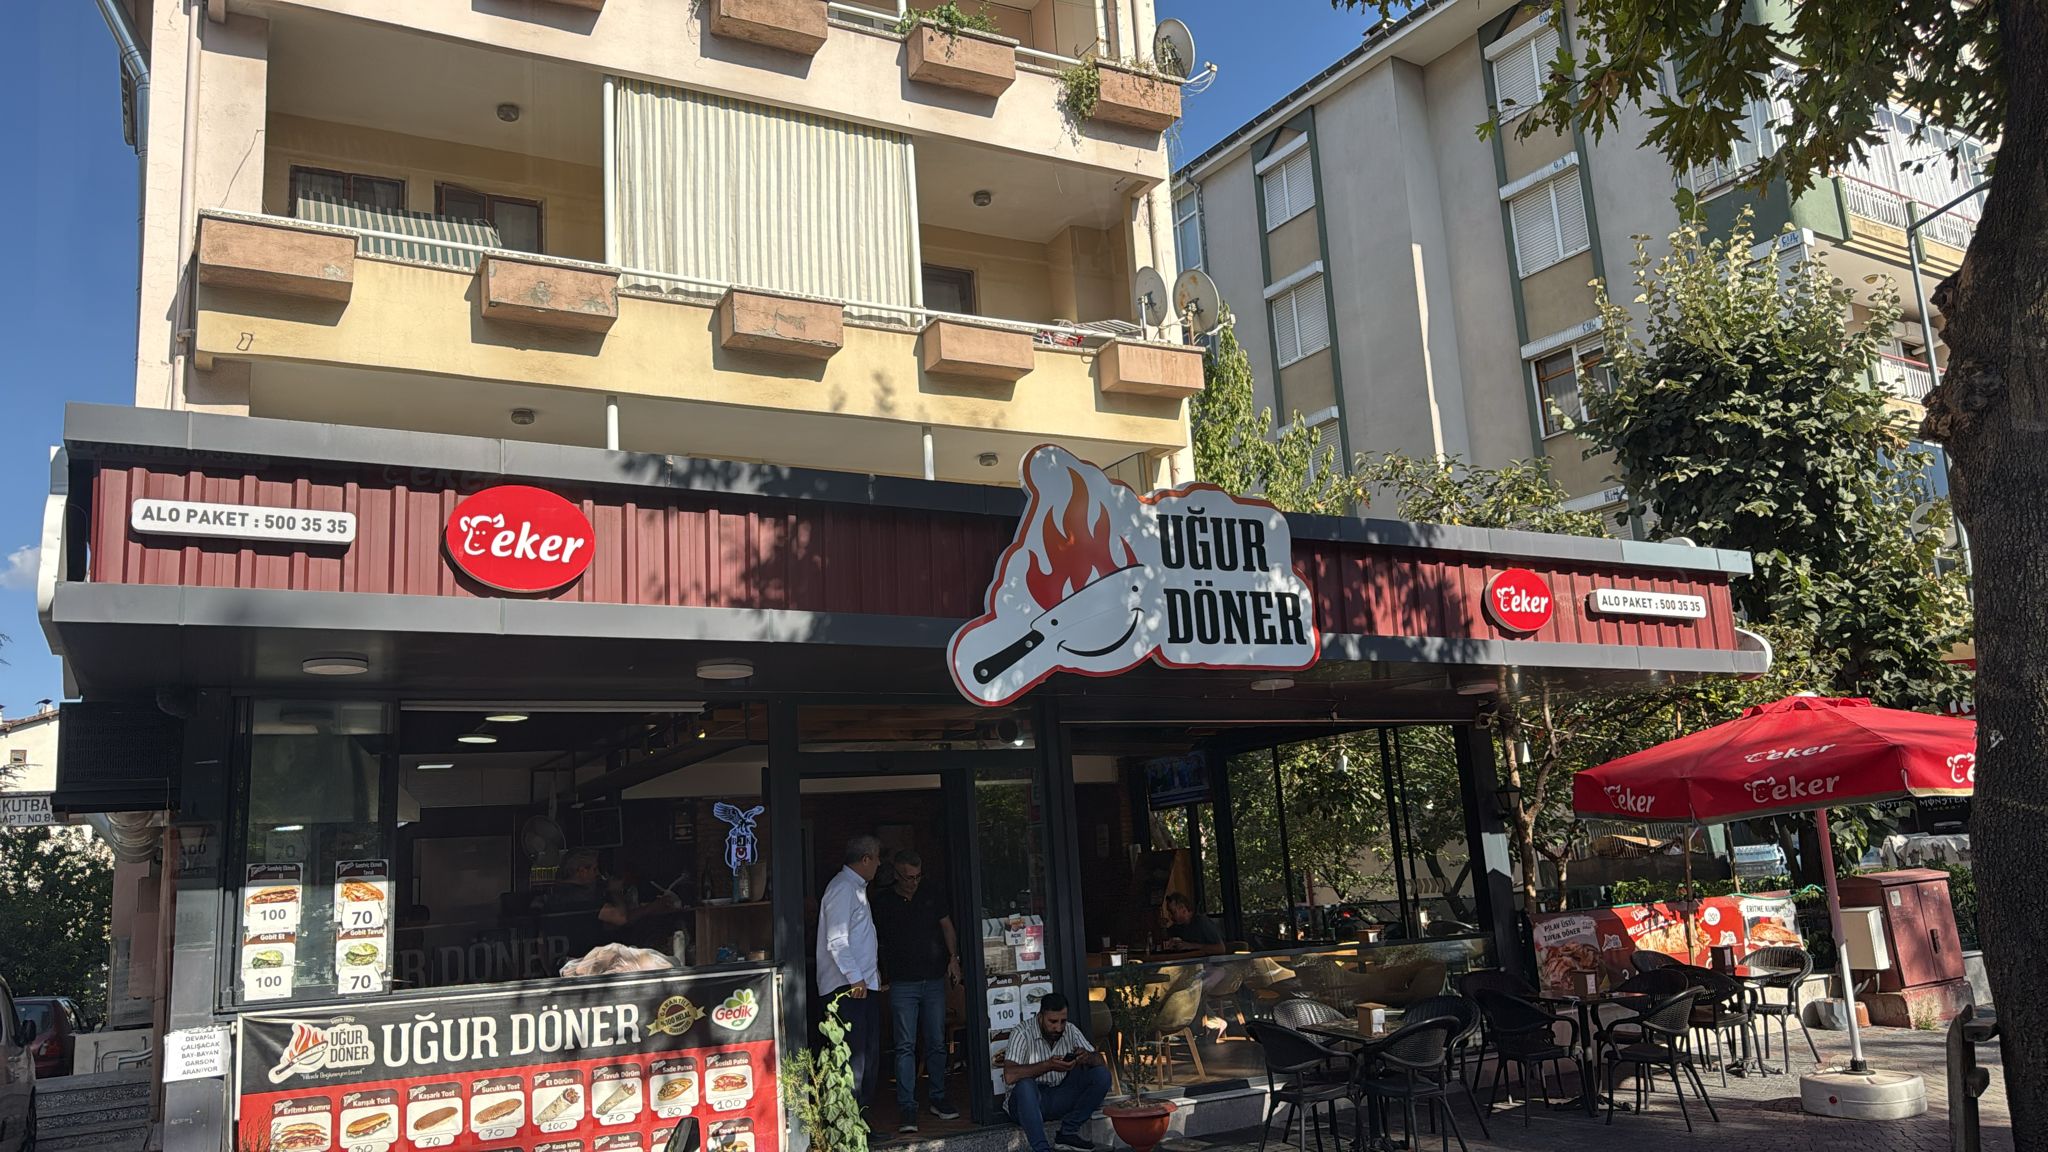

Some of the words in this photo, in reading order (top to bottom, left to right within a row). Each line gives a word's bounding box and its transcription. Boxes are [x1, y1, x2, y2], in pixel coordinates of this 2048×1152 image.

[142, 506, 180, 523] ALO
[186, 509, 249, 528] PAKET
[265, 515, 297, 532] 500
[301, 517, 323, 533] 35
[327, 520, 348, 534] 35
[491, 521, 585, 563] eker
[1156, 506, 1270, 572] UĞUR
[1511, 593, 1549, 613] eker
[1601, 596, 1620, 607] ALO
[1623, 597, 1653, 609] PAKET
[1660, 599, 1676, 610] 500
[1678, 600, 1689, 611] 35
[1690, 601, 1701, 612] 35
[1163, 580, 1307, 645] DÖNER
[260, 908, 286, 921] 100
[351, 910, 373, 925] 70
[256, 975, 282, 988] 100
[350, 975, 371, 990] 70
[715, 1004, 753, 1021] Gedik
[996, 1009, 1014, 1020] 100
[330, 1029, 363, 1046] UĞUR
[381, 1012, 499, 1067] UĞUR
[510, 1003, 641, 1056] DÖNER
[330, 1046, 370, 1063] DÖNER
[441, 1090, 455, 1098] Tost
[507, 1083, 521, 1091] Tost
[717, 1099, 741, 1110] 100
[608, 1113, 626, 1122] 70
[486, 1129, 505, 1138] 70
[547, 1121, 568, 1131] 100
[425, 1137, 440, 1147] 70
